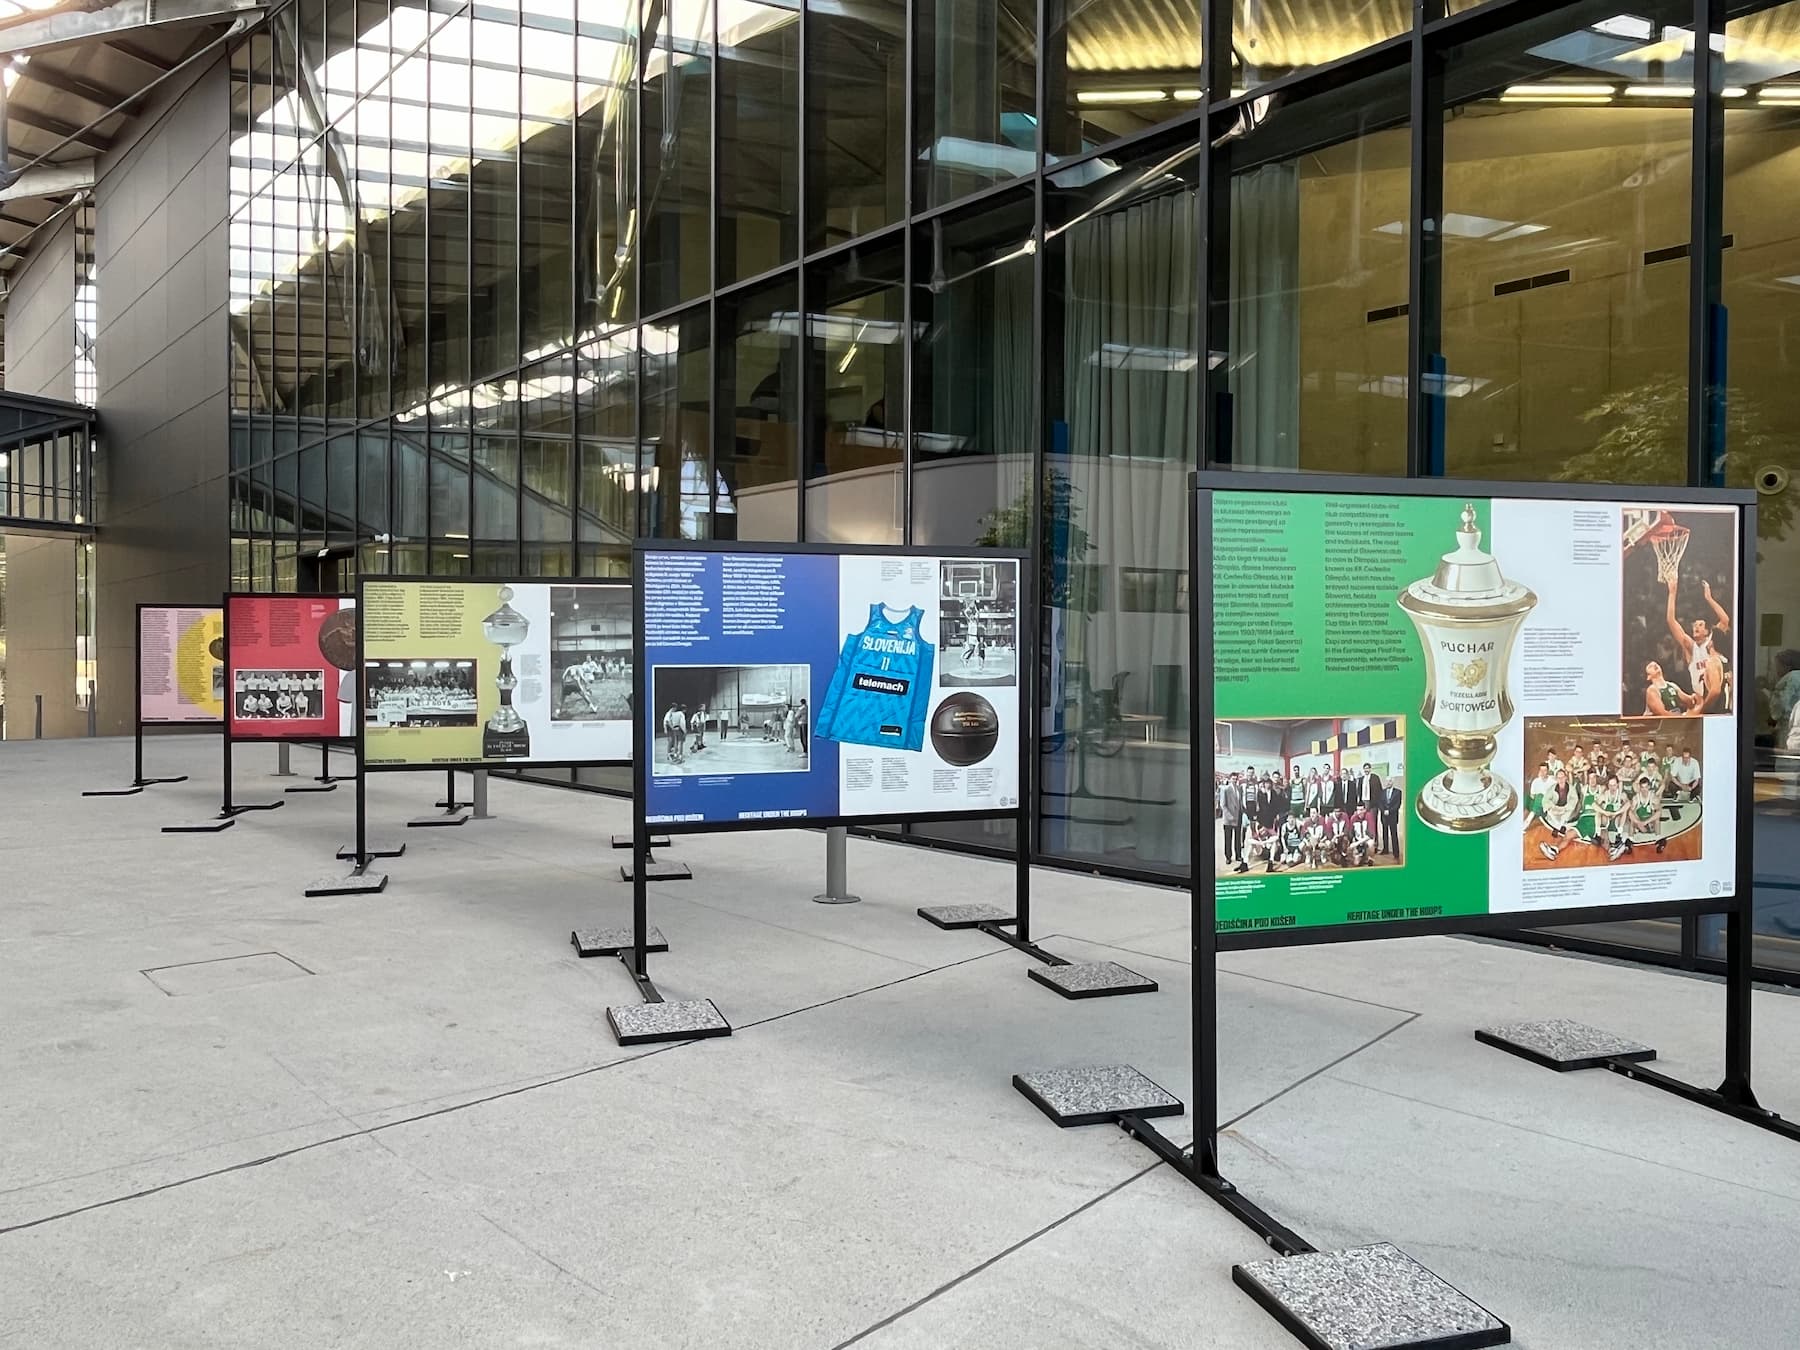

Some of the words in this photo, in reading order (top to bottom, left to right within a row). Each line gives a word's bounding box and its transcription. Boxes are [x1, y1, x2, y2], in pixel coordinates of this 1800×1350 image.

[862, 635, 916, 655] SLOVENIJA
[1440, 641, 1495, 654] PUCHAR
[858, 677, 904, 692] telemach
[1440, 699, 1496, 713] SPORTOWEGO
[1347, 910, 1380, 920] HERITAGE
[1381, 908, 1404, 919] UNDER
